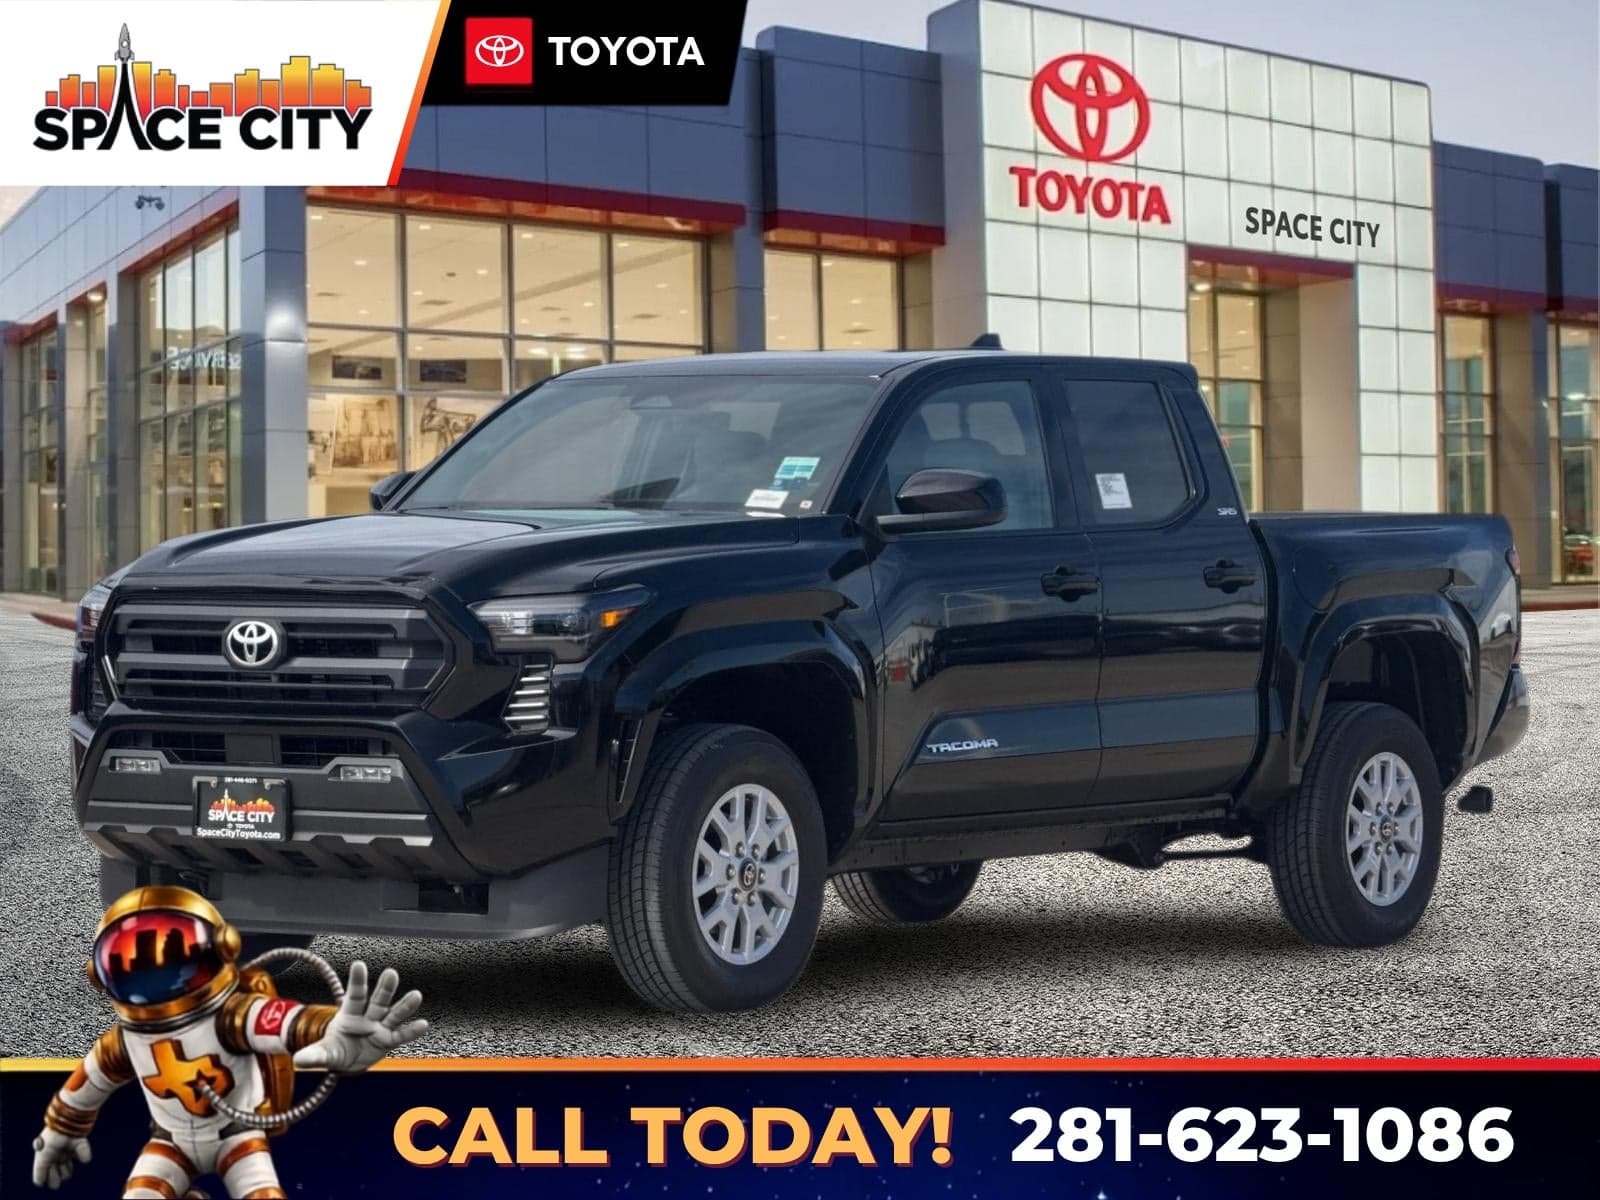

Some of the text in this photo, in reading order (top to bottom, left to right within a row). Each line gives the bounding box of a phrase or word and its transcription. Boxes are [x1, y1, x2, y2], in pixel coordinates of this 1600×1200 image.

[1009, 165, 1171, 225] TOYOTA
[1245, 206, 1381, 248] SPACE CITY
[926, 738, 999, 753] TACOMA
[208, 808, 275, 823] SPACE CITY
[197, 827, 281, 839] SpaceCityToyota.com
